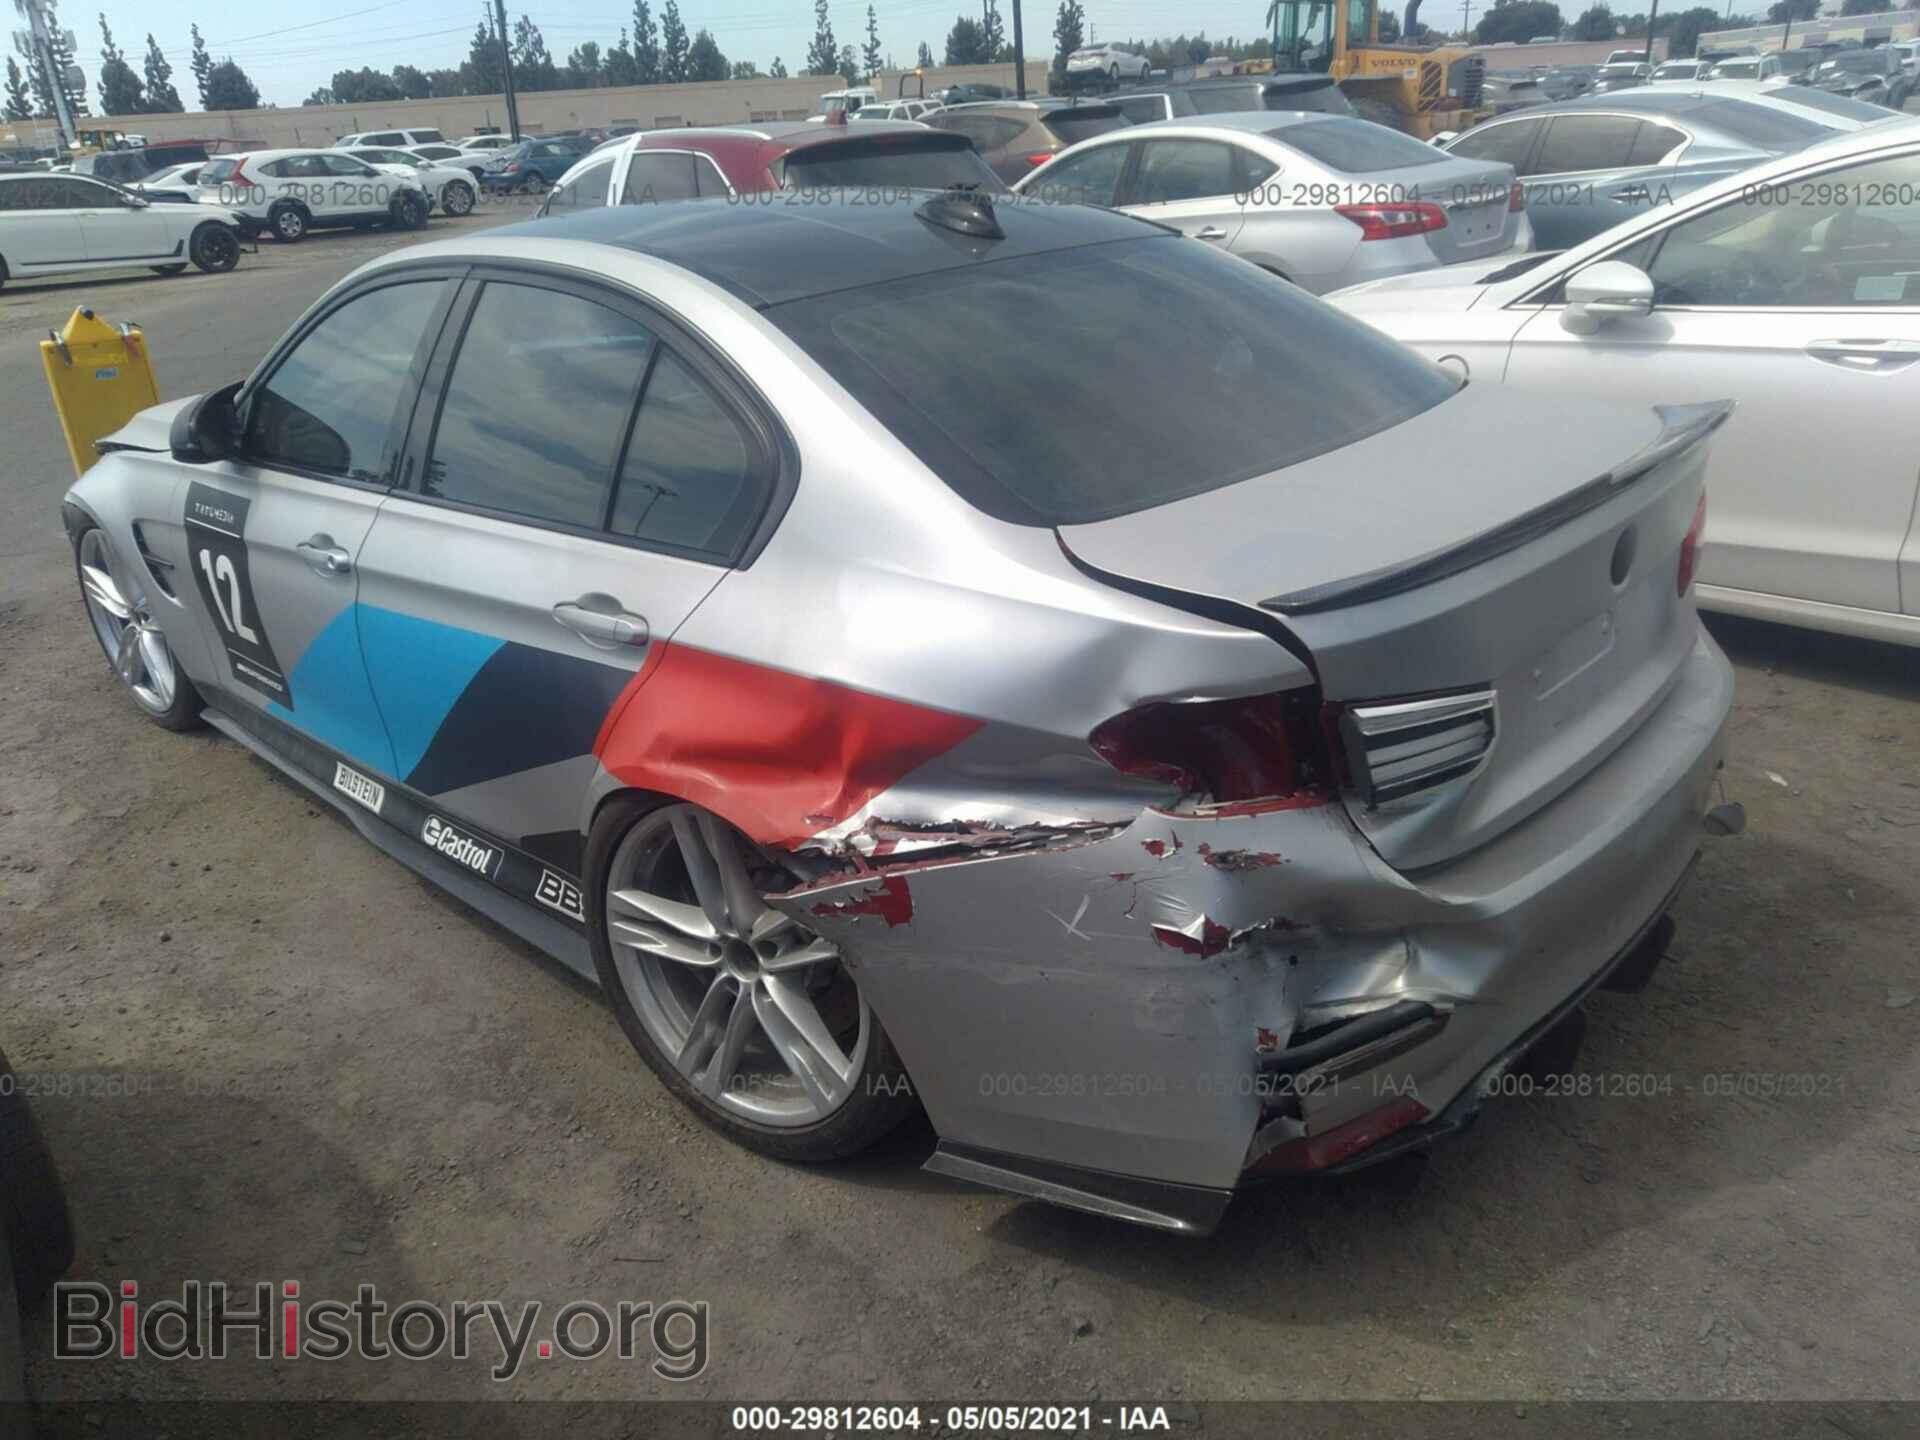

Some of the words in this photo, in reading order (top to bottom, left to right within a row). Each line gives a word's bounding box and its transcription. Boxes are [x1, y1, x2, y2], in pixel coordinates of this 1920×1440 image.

[200, 548, 259, 645] 12
[338, 766, 381, 807] BILSTEIN
[437, 826, 493, 874] Castrol
[537, 870, 584, 919] BB
